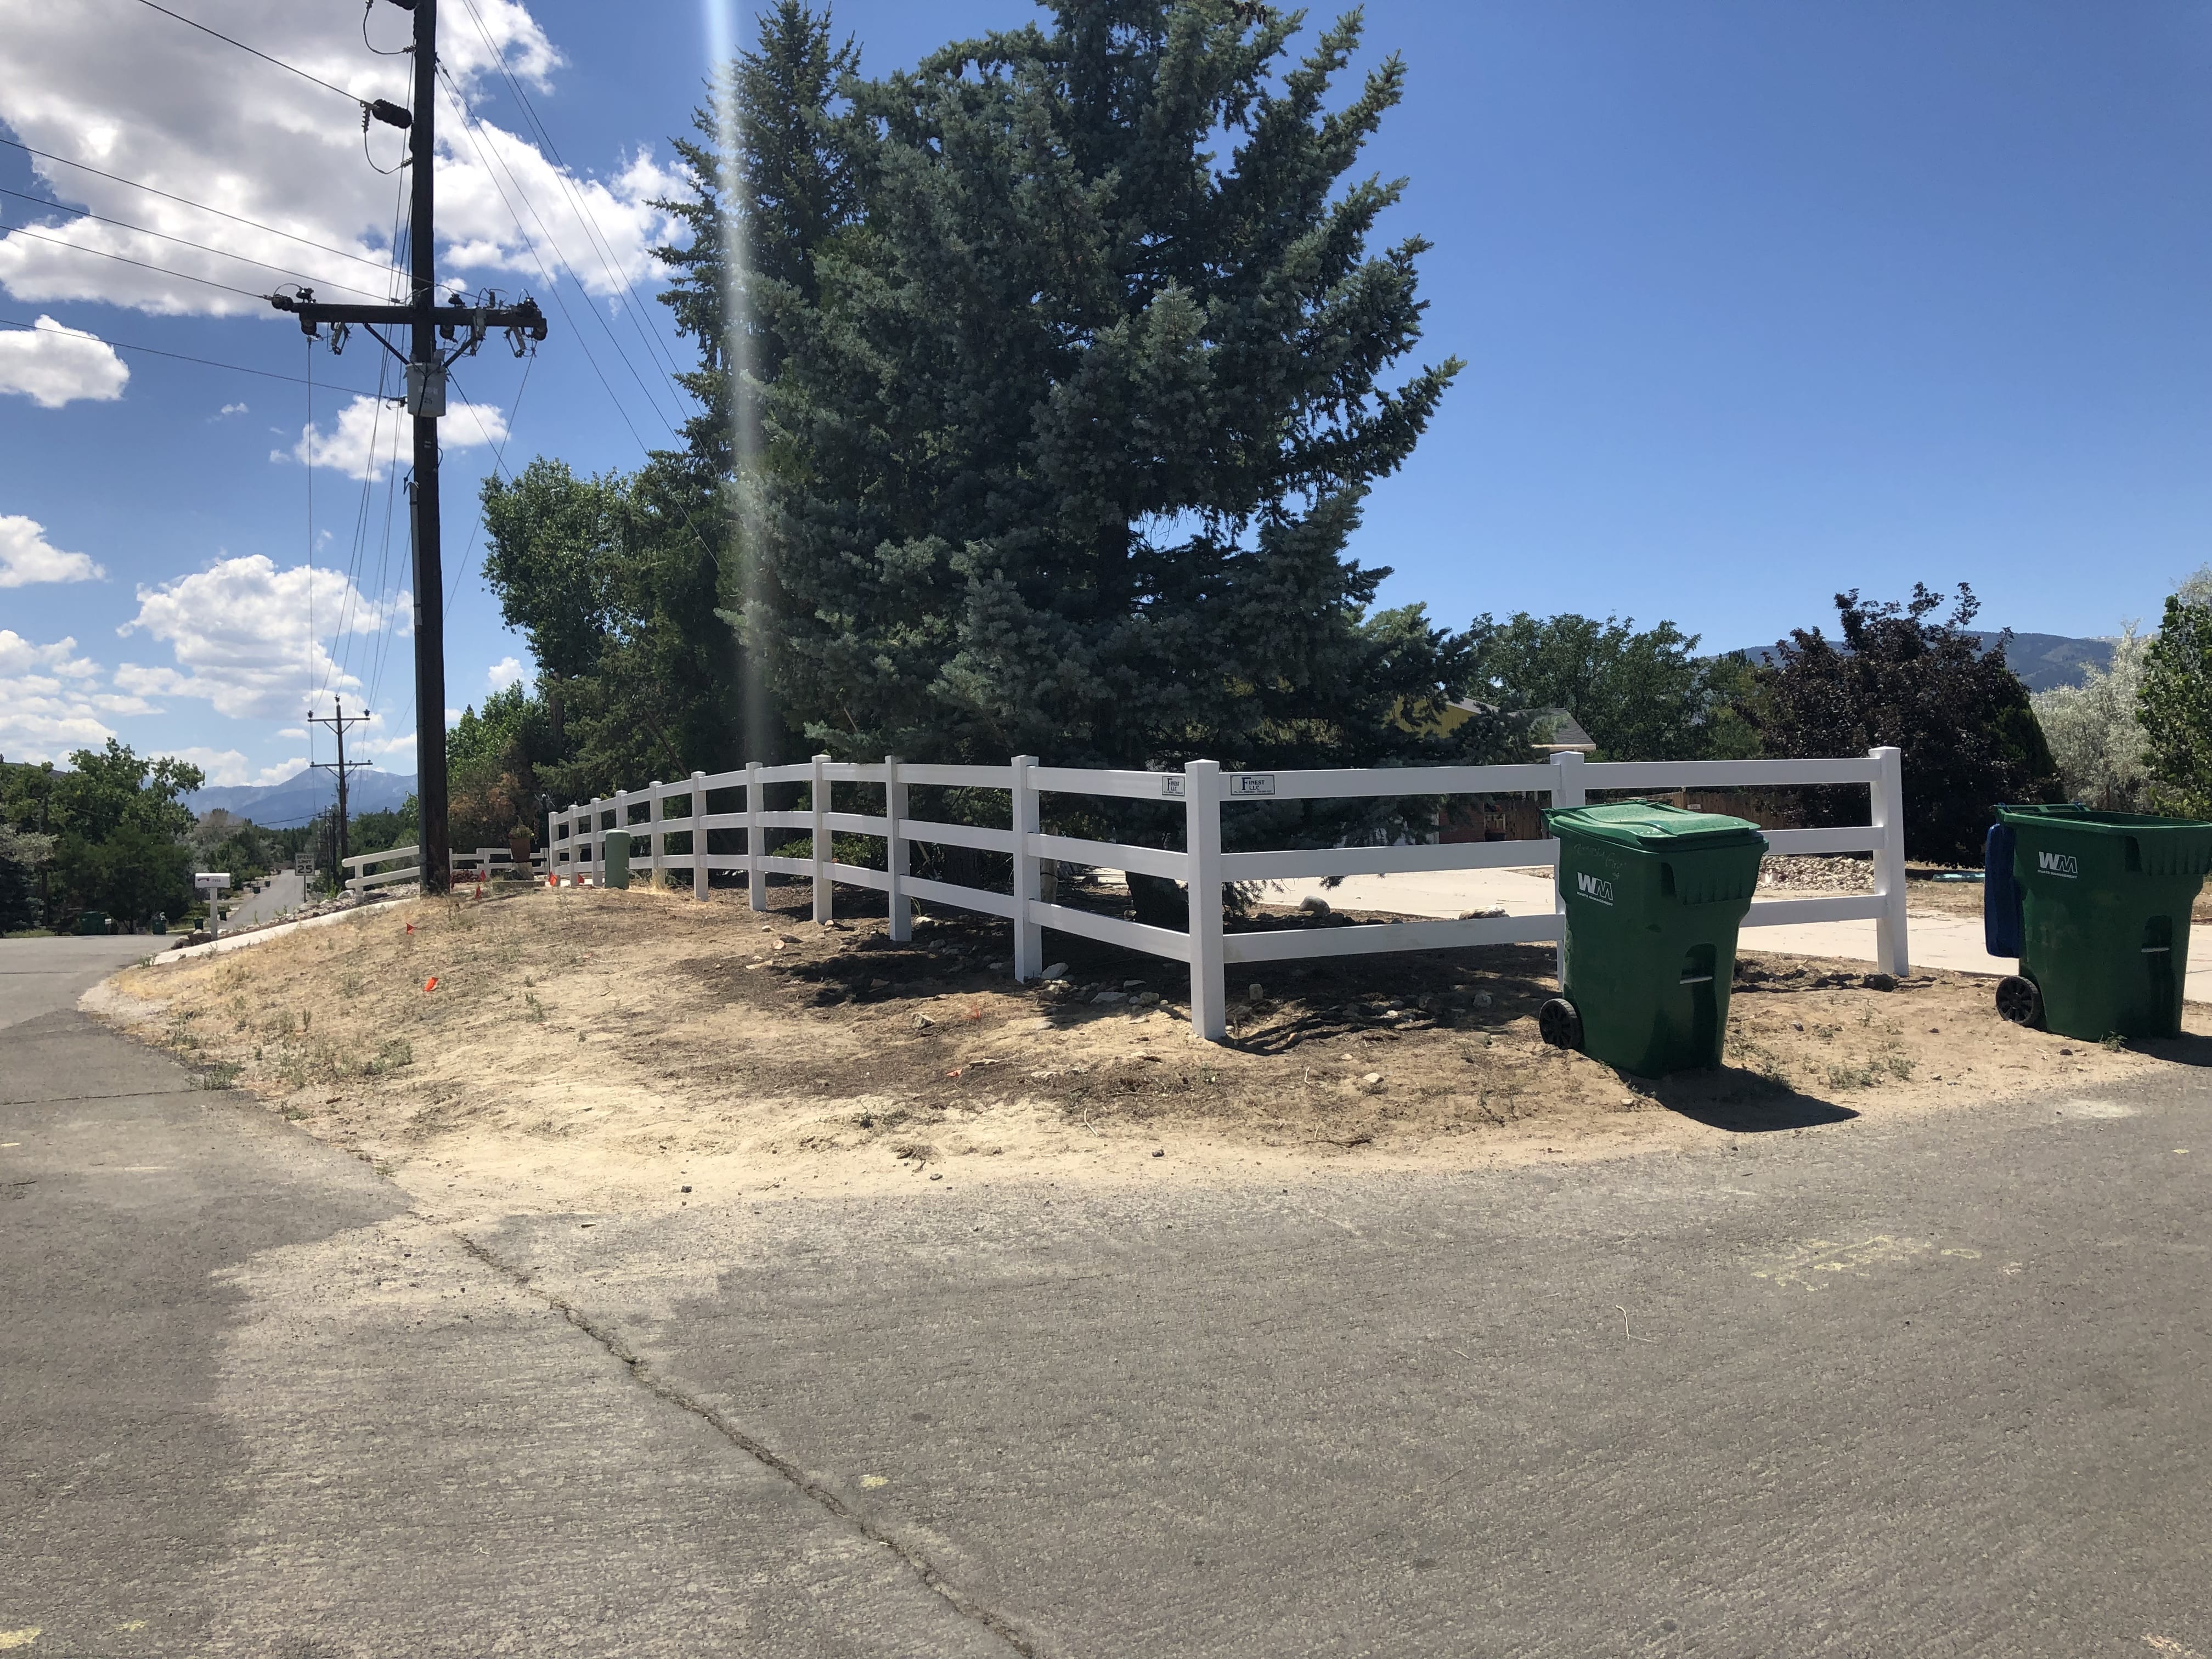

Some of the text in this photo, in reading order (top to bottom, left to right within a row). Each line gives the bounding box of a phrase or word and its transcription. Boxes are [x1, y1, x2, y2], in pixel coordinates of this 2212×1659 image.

[1167, 778, 1180, 791] FINEST
[1241, 777, 1265, 791] FINEST
[297, 865, 313, 873] 25
[2039, 851, 2078, 874] WM
[1577, 872, 1613, 901] WM
